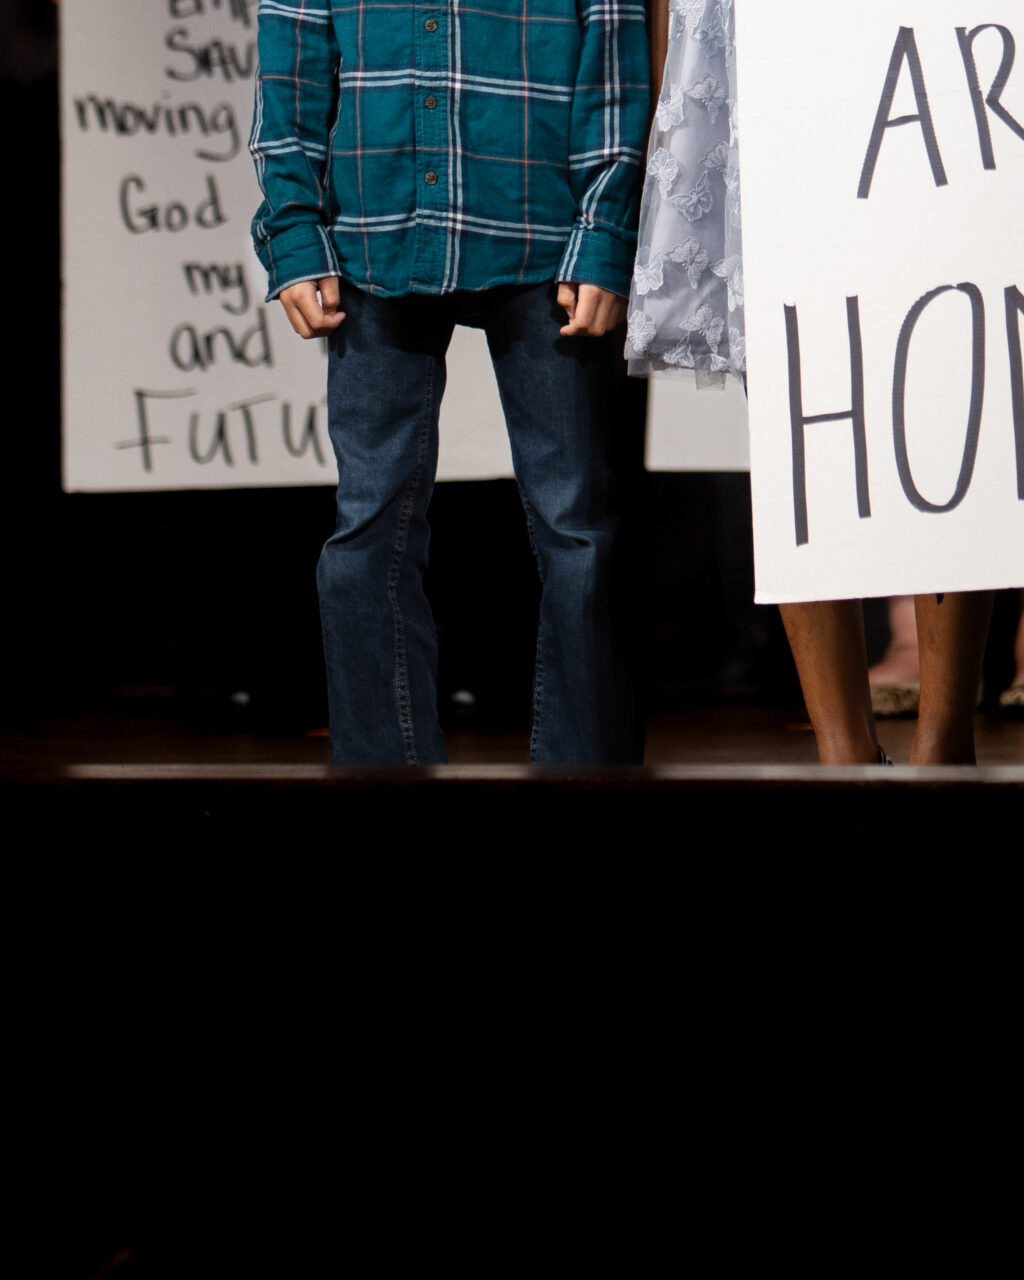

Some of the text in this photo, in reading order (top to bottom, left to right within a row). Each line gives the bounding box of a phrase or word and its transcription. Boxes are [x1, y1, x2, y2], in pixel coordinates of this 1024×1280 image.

[74, 89, 243, 163] moving
[119, 173, 231, 236] God
[183, 261, 250, 317] my
[169, 306, 274, 372] and
